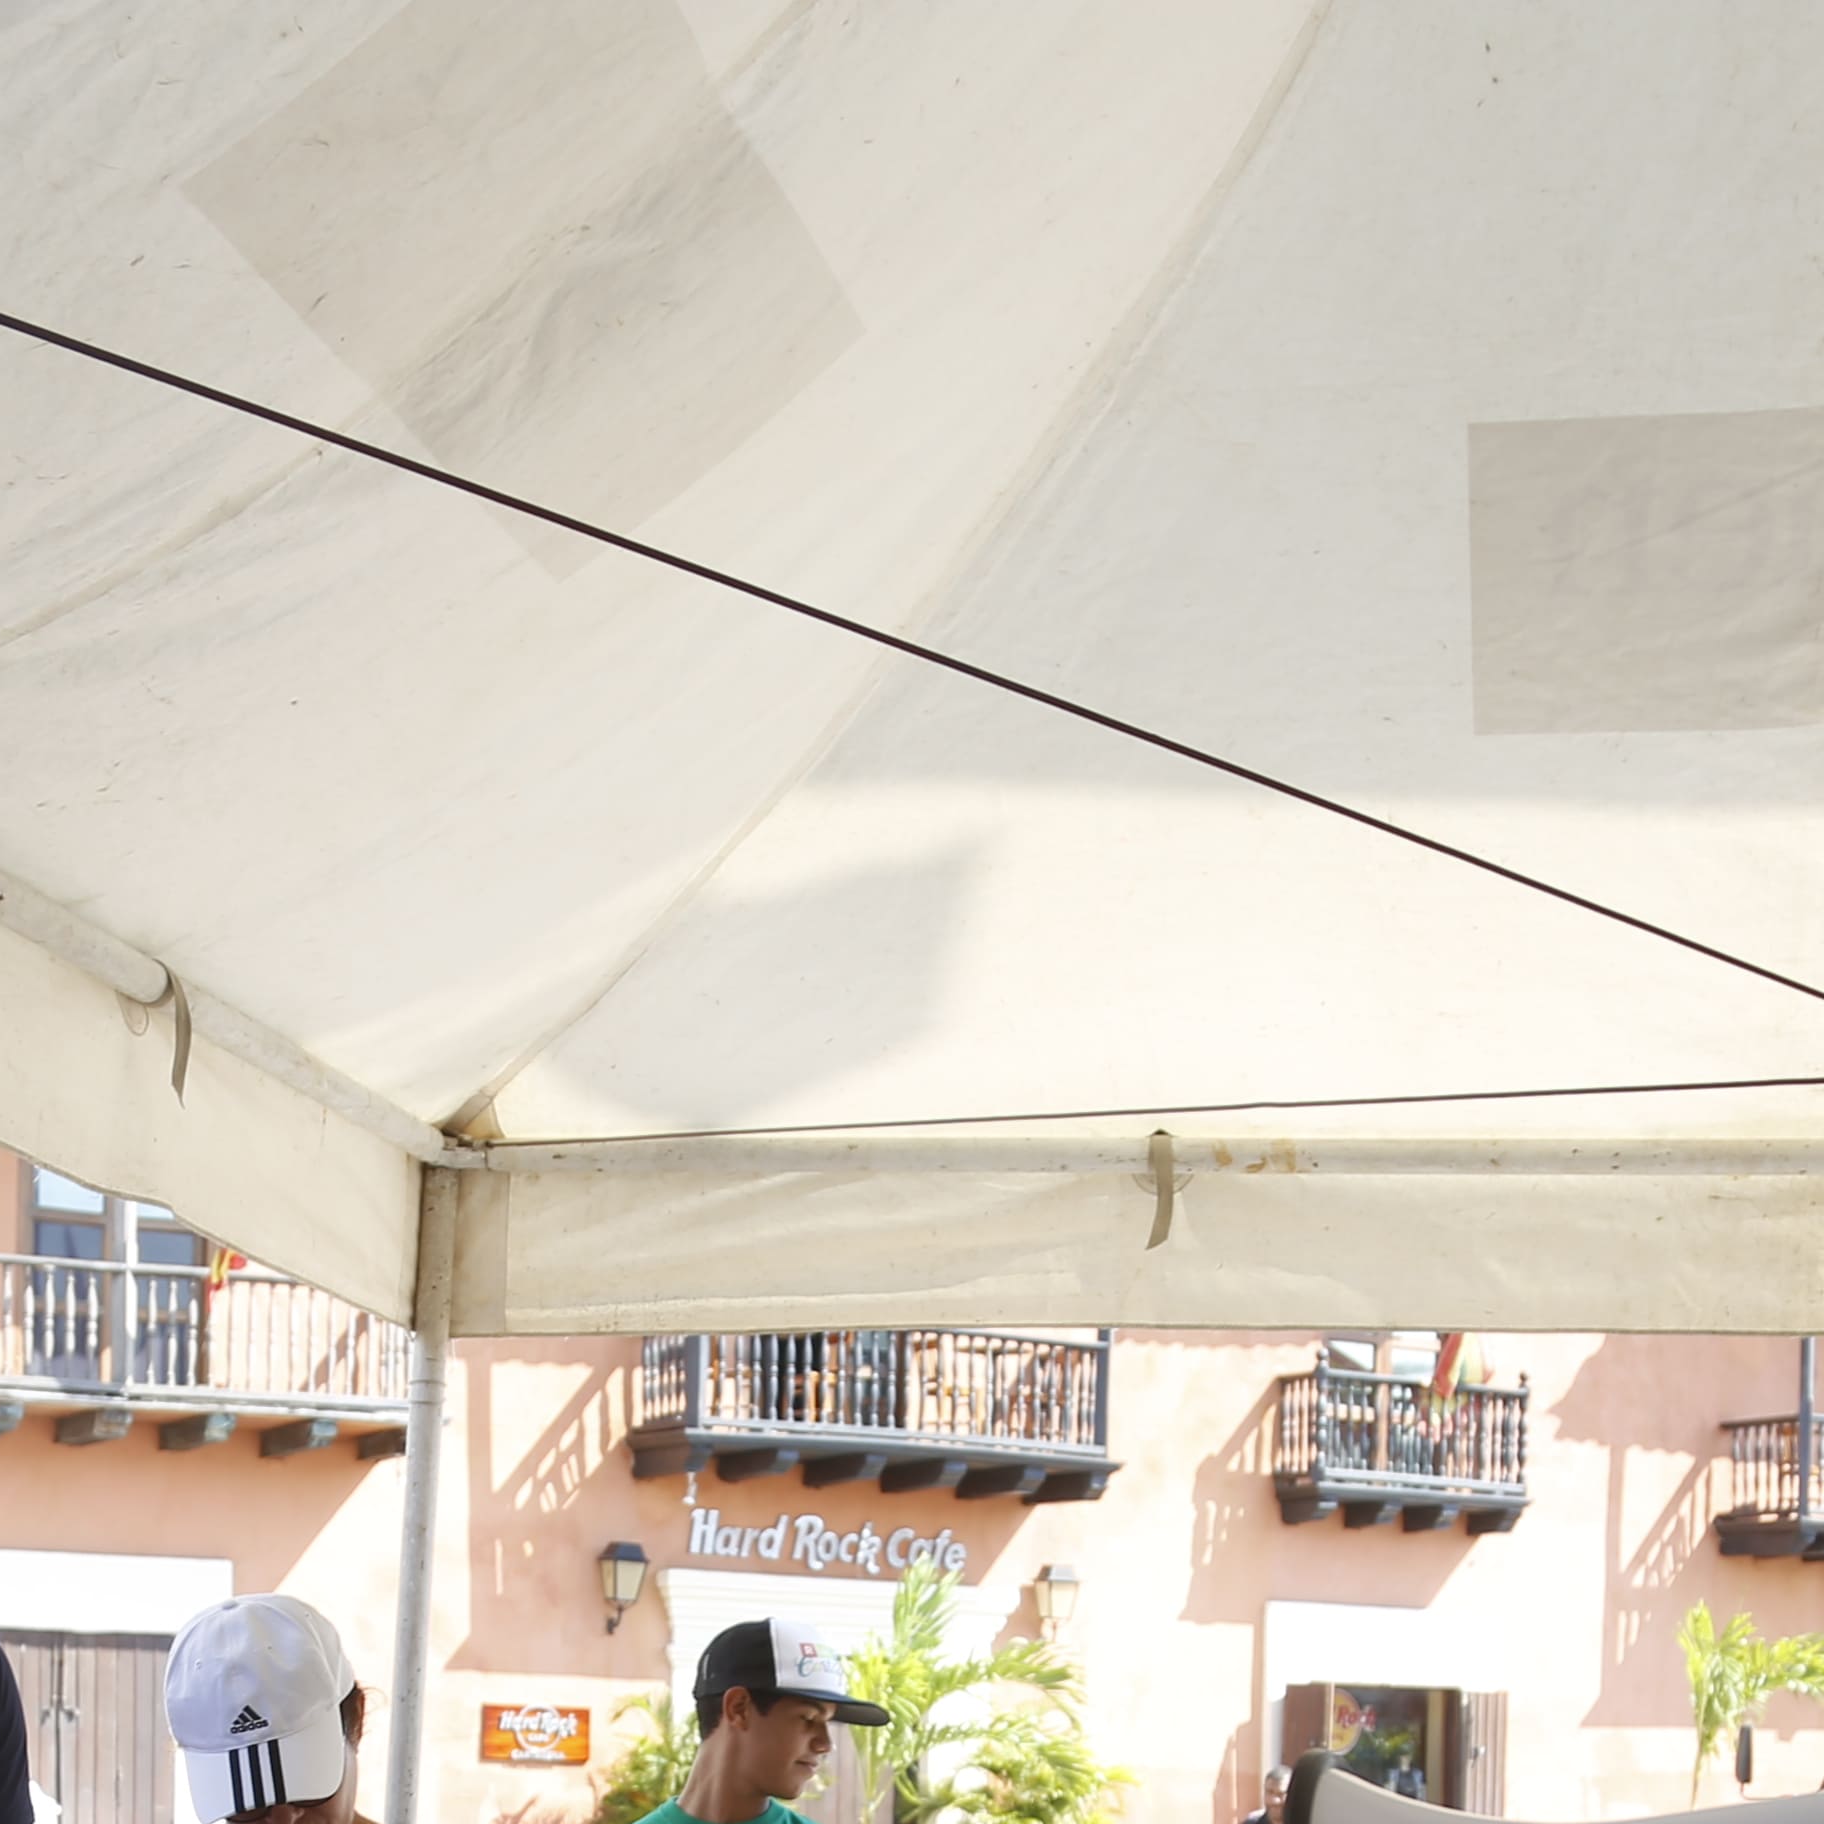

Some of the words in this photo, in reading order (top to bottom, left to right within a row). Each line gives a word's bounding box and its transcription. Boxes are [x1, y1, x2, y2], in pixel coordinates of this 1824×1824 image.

[689, 1508, 789, 1560] Hard
[792, 1513, 882, 1575] Rock
[886, 1527, 968, 1571] Cafe
[230, 1719, 269, 1735] adidas
